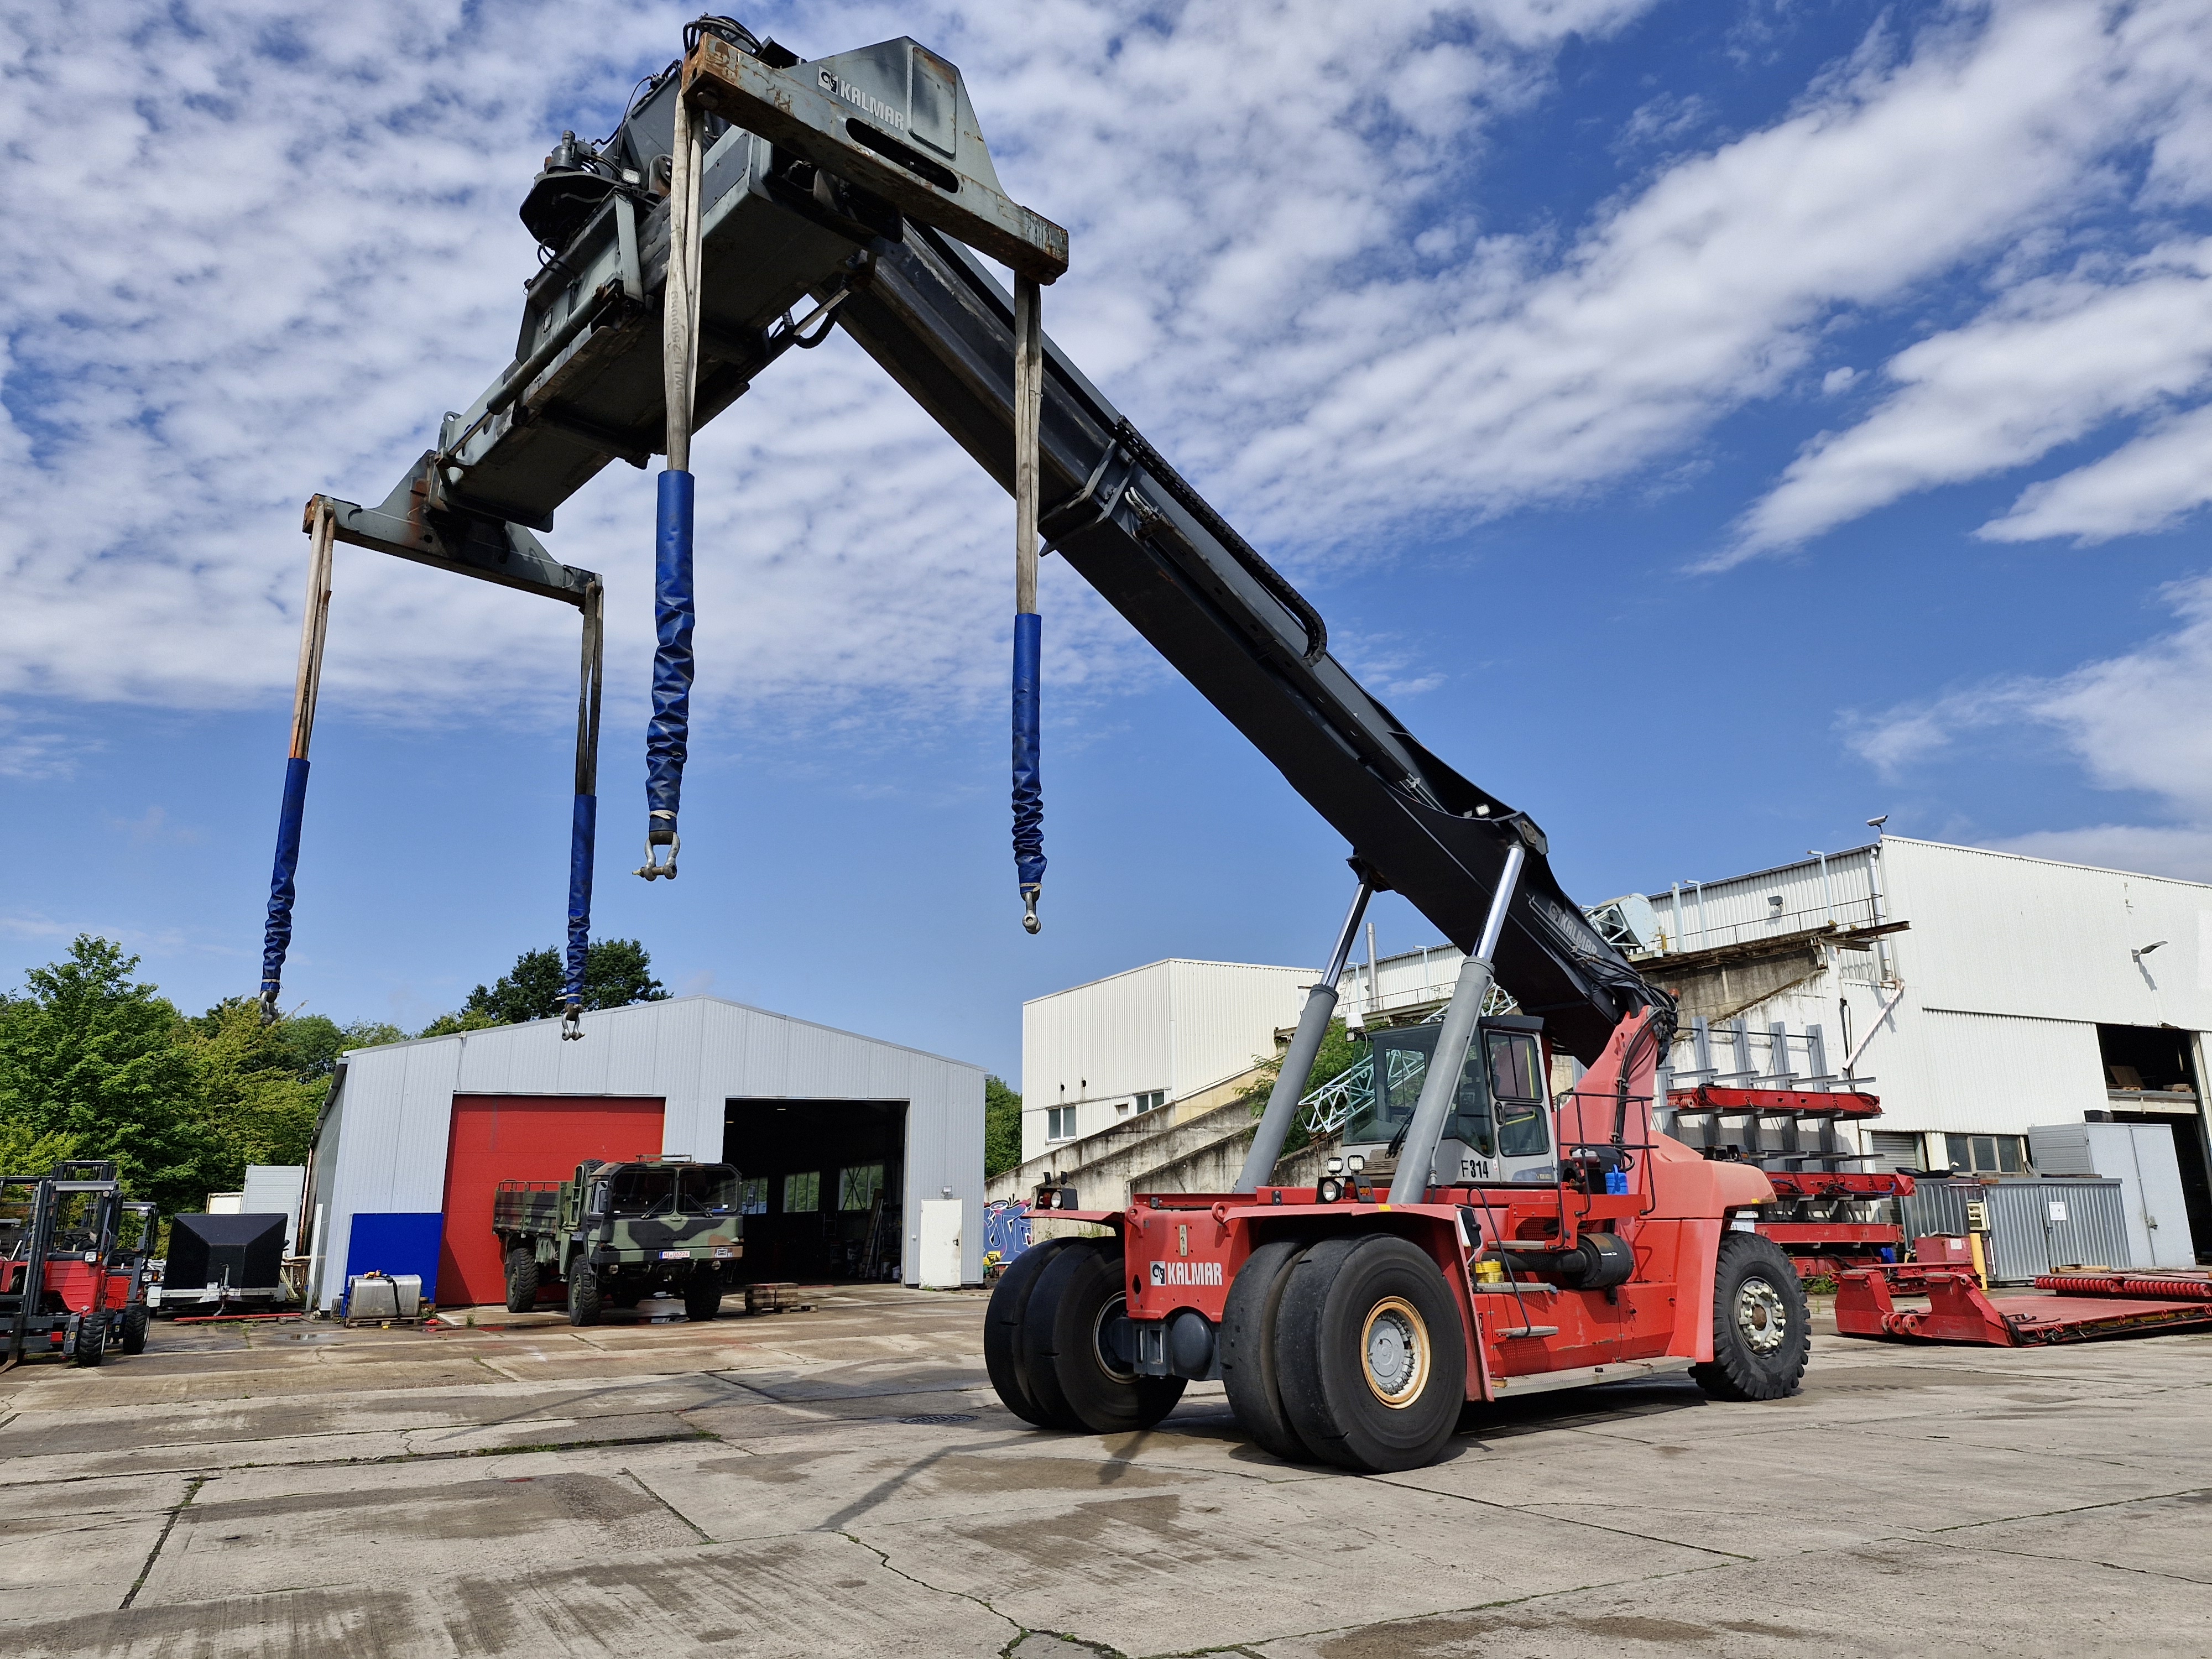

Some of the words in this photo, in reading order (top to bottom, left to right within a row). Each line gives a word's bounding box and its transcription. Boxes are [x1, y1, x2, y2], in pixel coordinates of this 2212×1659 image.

[841, 80, 904, 131] KALMAR
[674, 357, 684, 390] WLL
[1461, 1160, 1489, 1178] F314
[1167, 1262, 1223, 1286] KALMAR
